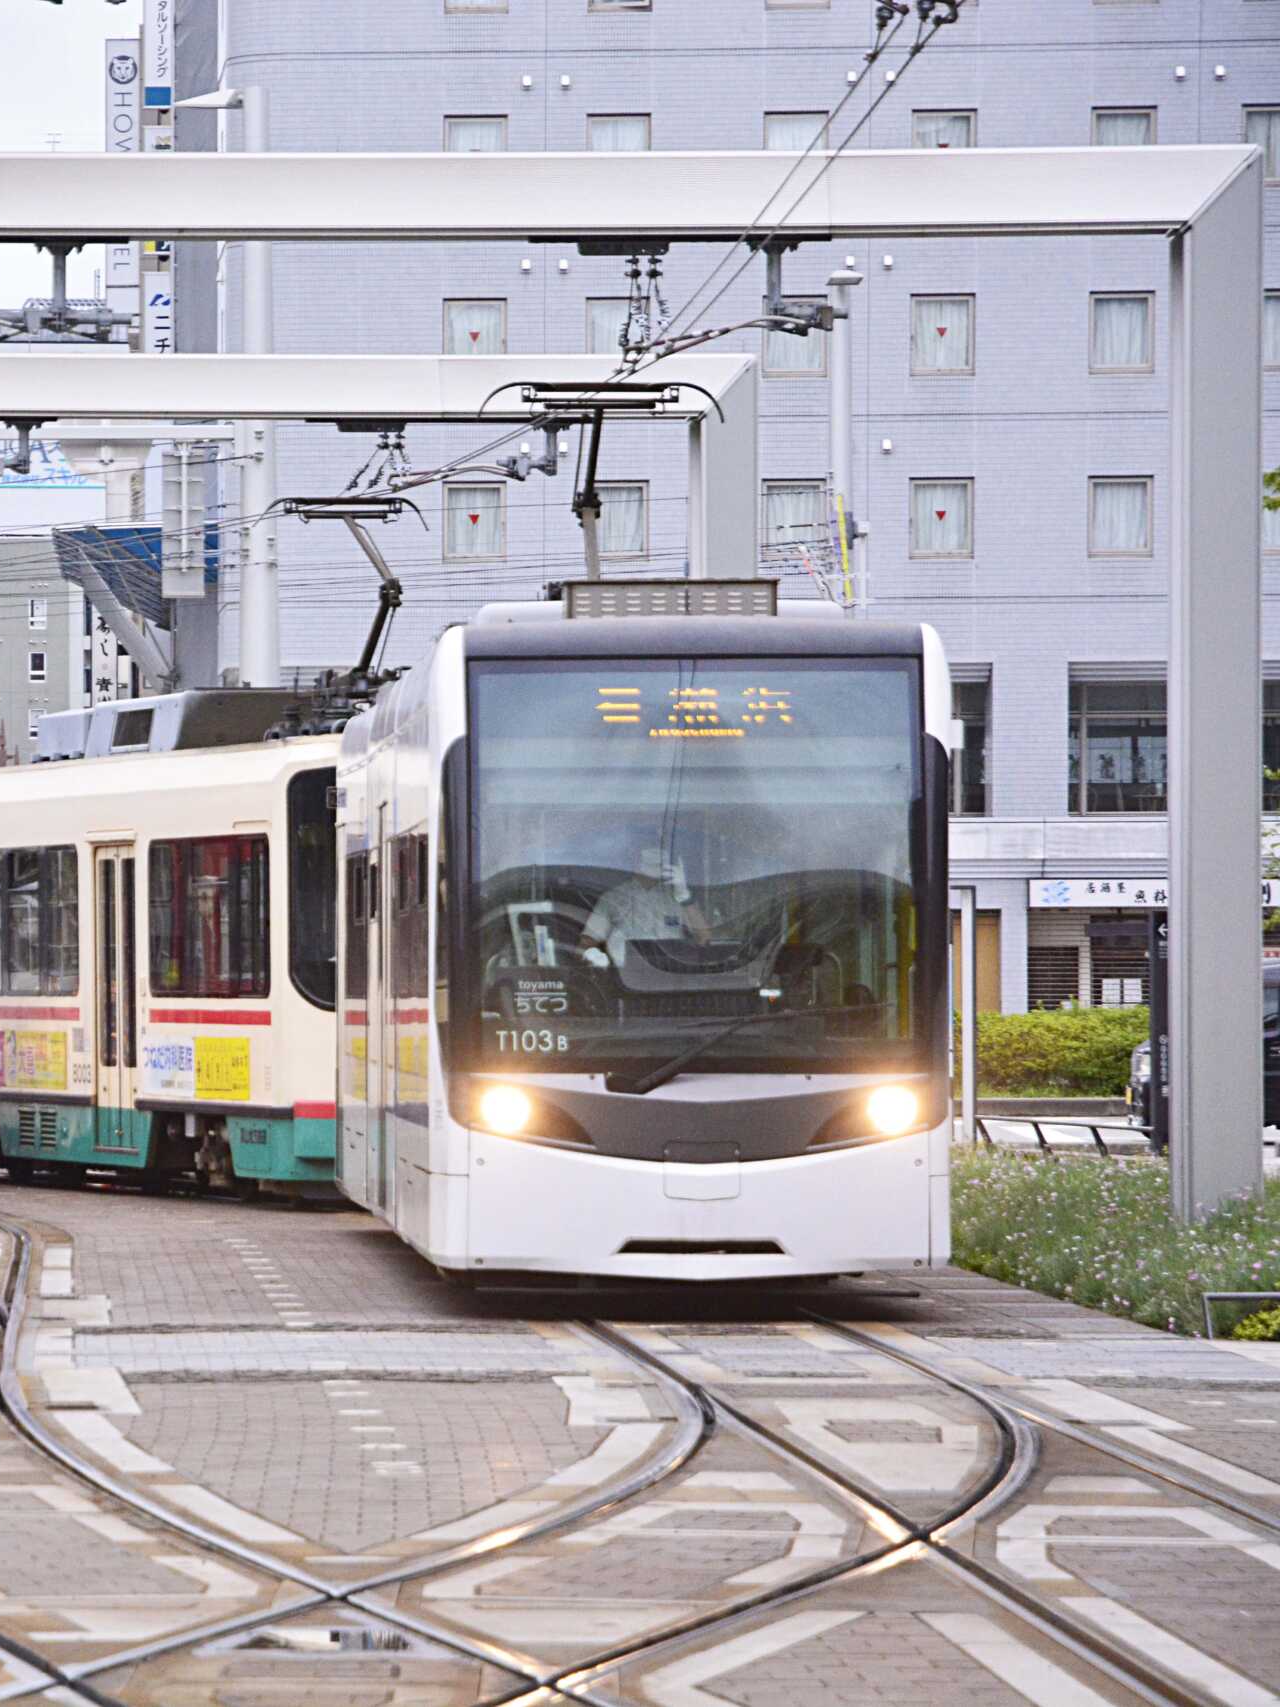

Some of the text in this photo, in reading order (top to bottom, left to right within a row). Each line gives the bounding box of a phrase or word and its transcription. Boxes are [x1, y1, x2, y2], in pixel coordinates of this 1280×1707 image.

[518, 980, 564, 992] toyama
[514, 997, 568, 1013] ちてつ
